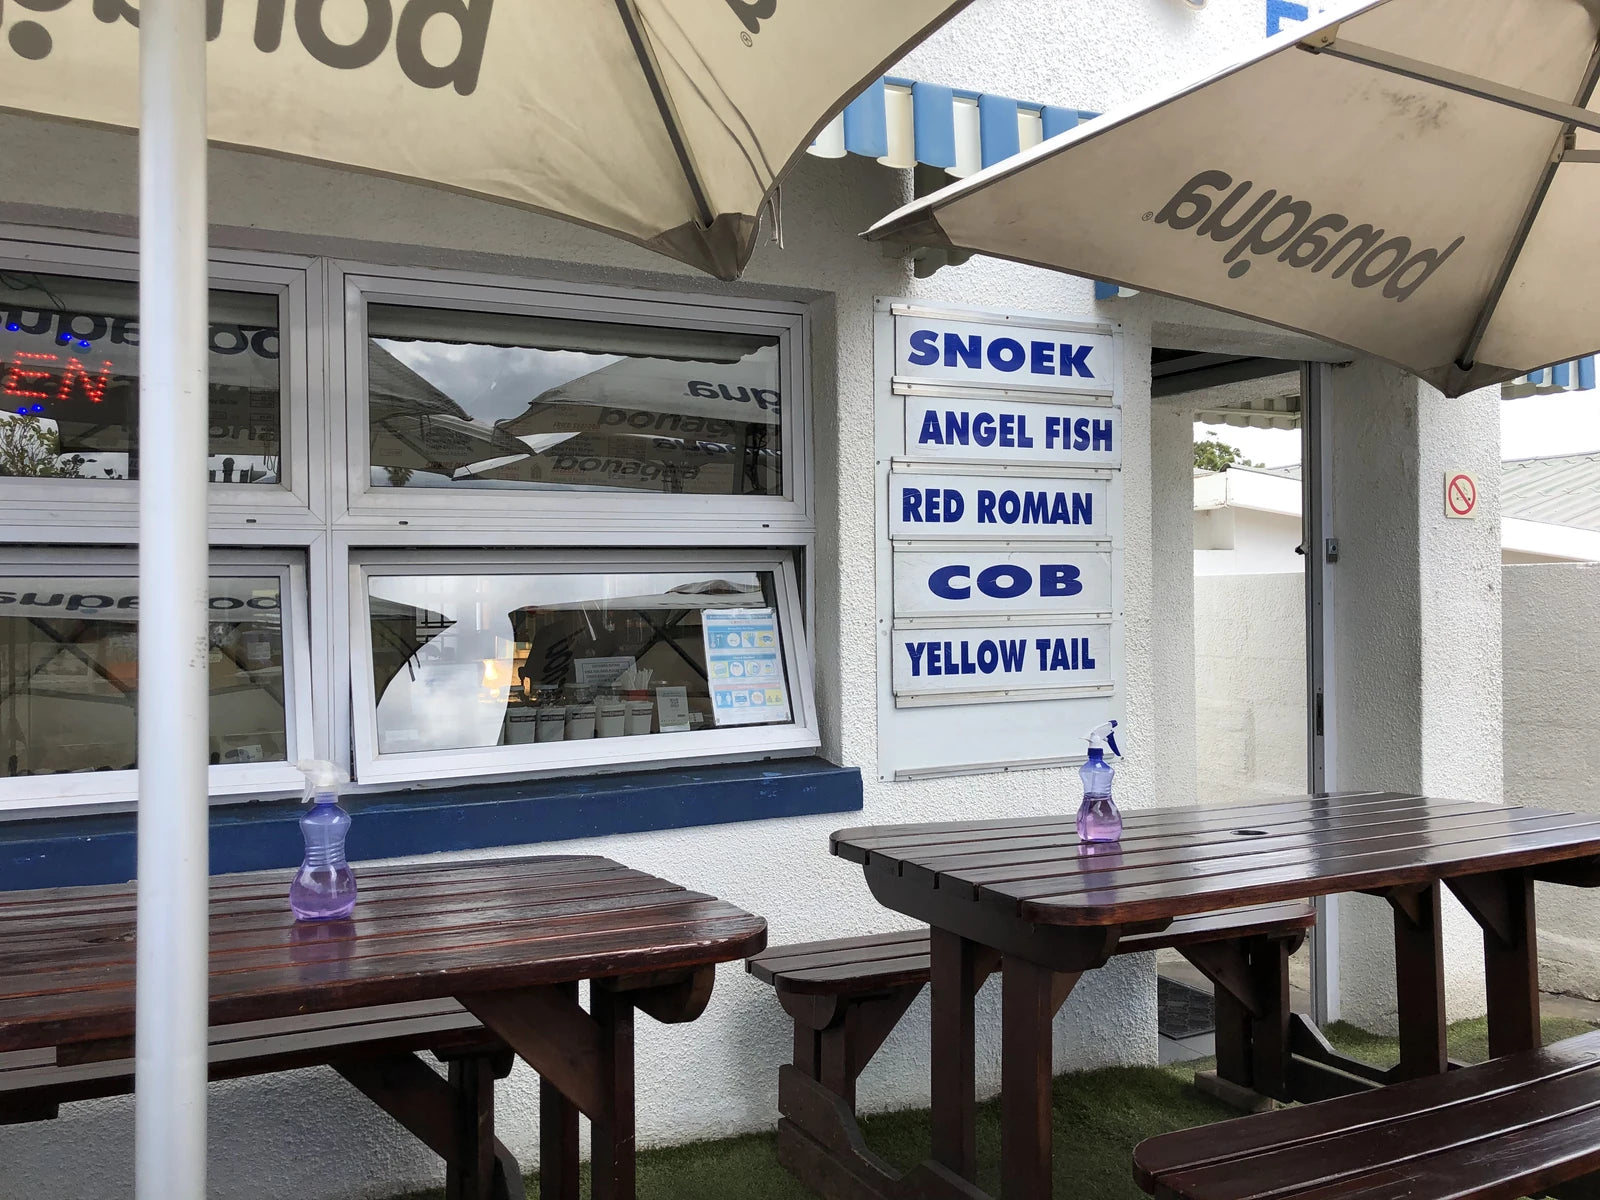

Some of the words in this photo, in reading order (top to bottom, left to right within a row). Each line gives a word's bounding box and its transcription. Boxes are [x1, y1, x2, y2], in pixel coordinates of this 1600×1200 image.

[907, 329, 1096, 379] SNOEK
[918, 409, 1034, 449] ANGEL
[1045, 416, 1113, 452] FISH
[902, 487, 965, 523] RED
[977, 489, 1093, 525] ROMAN
[928, 564, 1083, 600] COB
[905, 639, 1027, 676] YELLOW
[1036, 637, 1096, 672] TAIL
